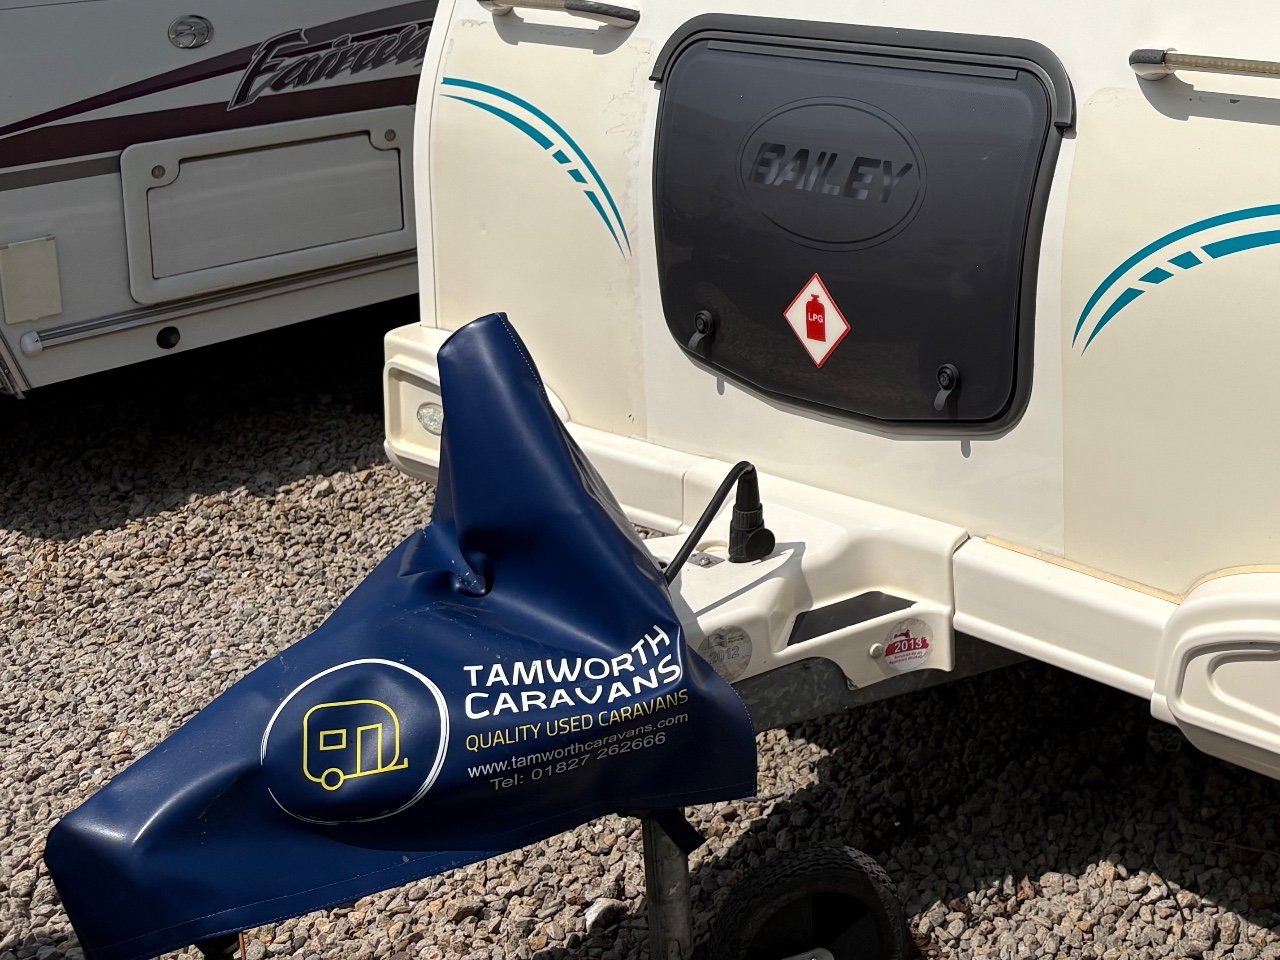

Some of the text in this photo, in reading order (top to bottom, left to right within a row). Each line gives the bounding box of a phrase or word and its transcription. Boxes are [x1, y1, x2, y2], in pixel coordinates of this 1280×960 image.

[753, 142, 913, 203] BAILEY
[808, 312, 824, 323] LPG
[463, 624, 671, 687] TAMWORTH
[465, 654, 682, 720] CARAVANS
[466, 689, 689, 752] QUALITY USED CARAVANS
[467, 713, 689, 779] www.tamworthcaravans.com
[490, 732, 666, 791] Tel: 01827 262666
